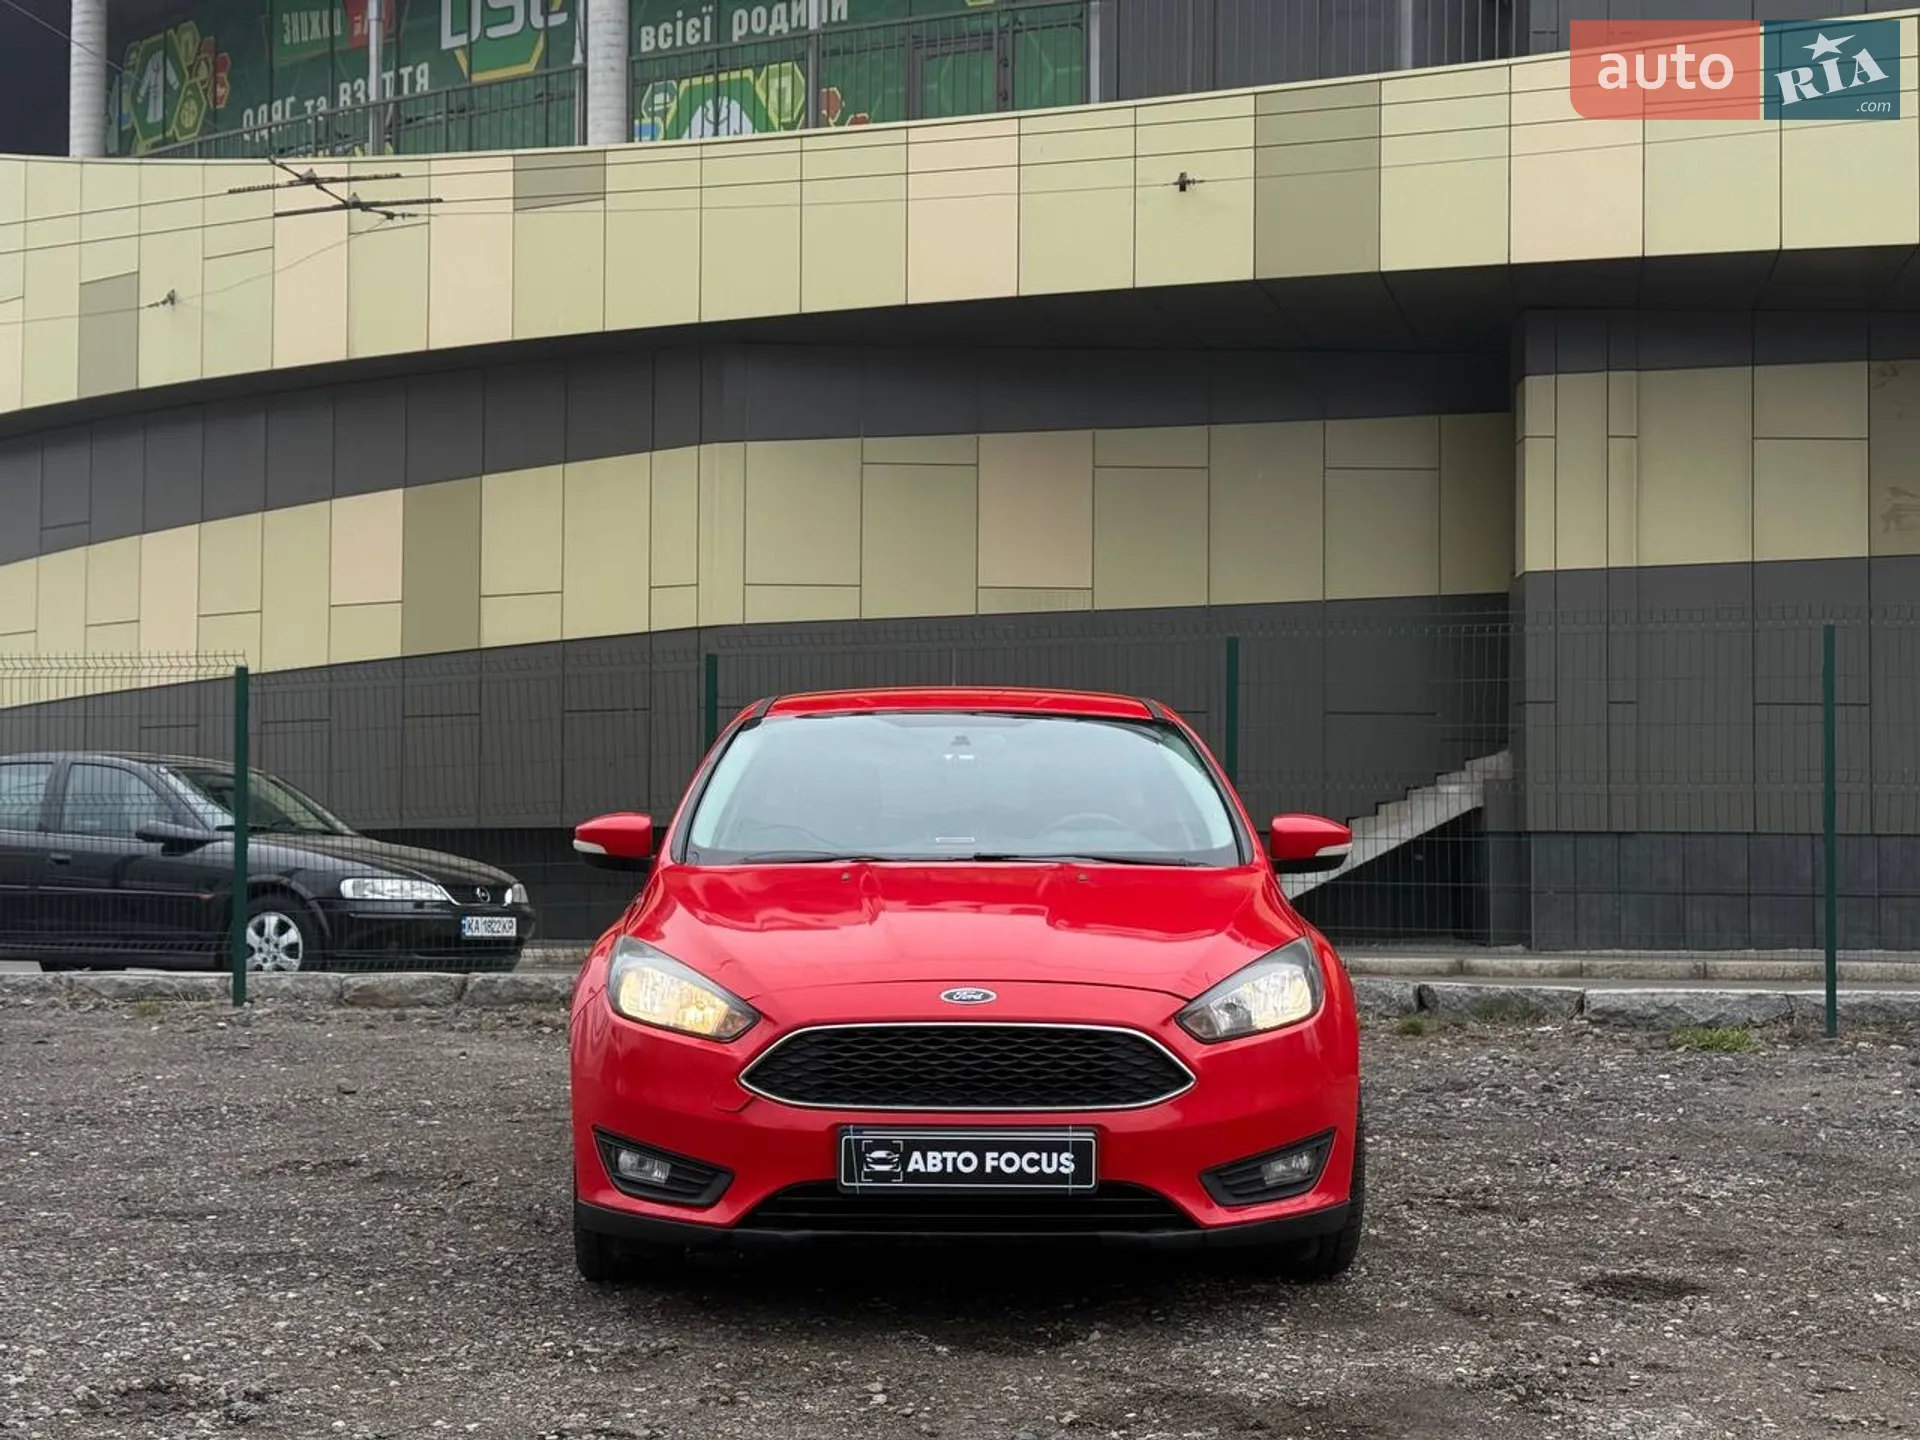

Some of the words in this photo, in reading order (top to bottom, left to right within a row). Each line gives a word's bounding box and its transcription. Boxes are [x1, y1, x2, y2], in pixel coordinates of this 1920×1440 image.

[640, 5, 713, 52] всієї
[338, 62, 429, 117] ВЗТТЯ
[952, 990, 984, 1001] Ford
[985, 1151, 1076, 1174] FOCUS
